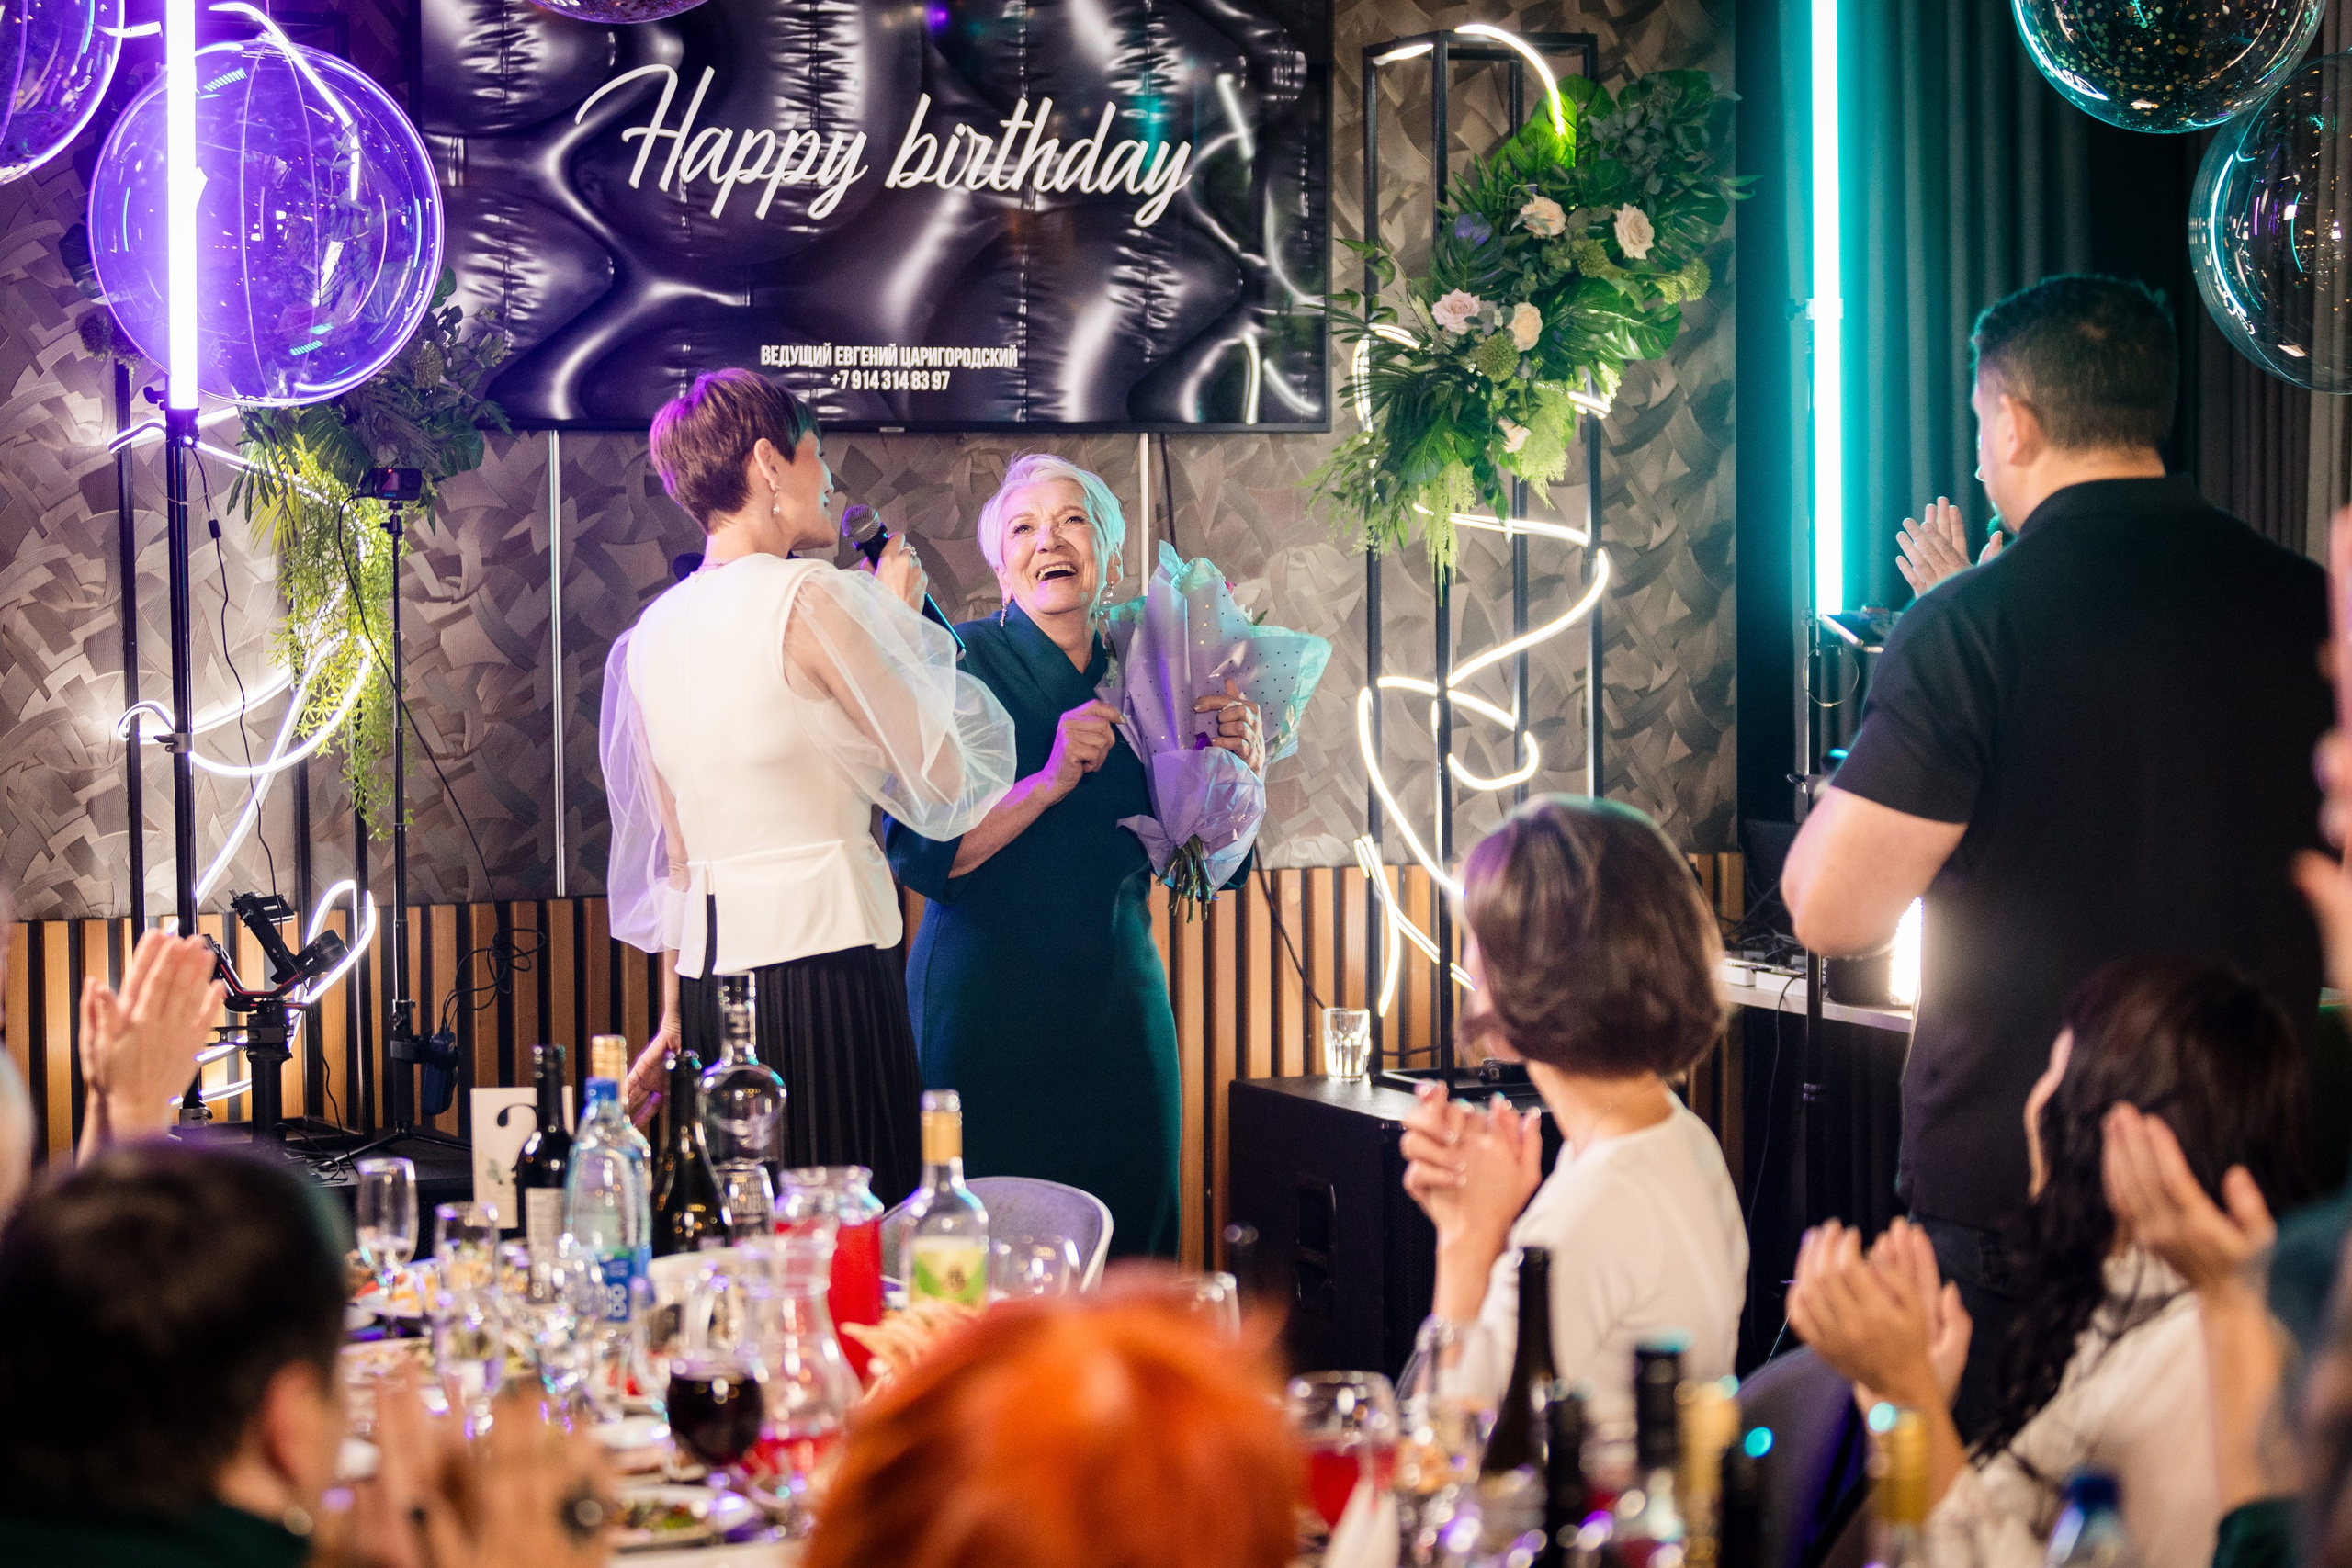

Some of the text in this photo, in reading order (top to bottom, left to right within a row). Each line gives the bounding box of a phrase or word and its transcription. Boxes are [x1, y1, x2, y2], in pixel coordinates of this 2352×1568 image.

[575, 64, 1193, 227] Happy birthday
[761, 342, 1019, 369] ВЕДУЩИЙ ЕВГЕНИЙ ЦАРИГОРОДСКИЙ
[830, 369, 951, 391] +7 914 314 83 97
